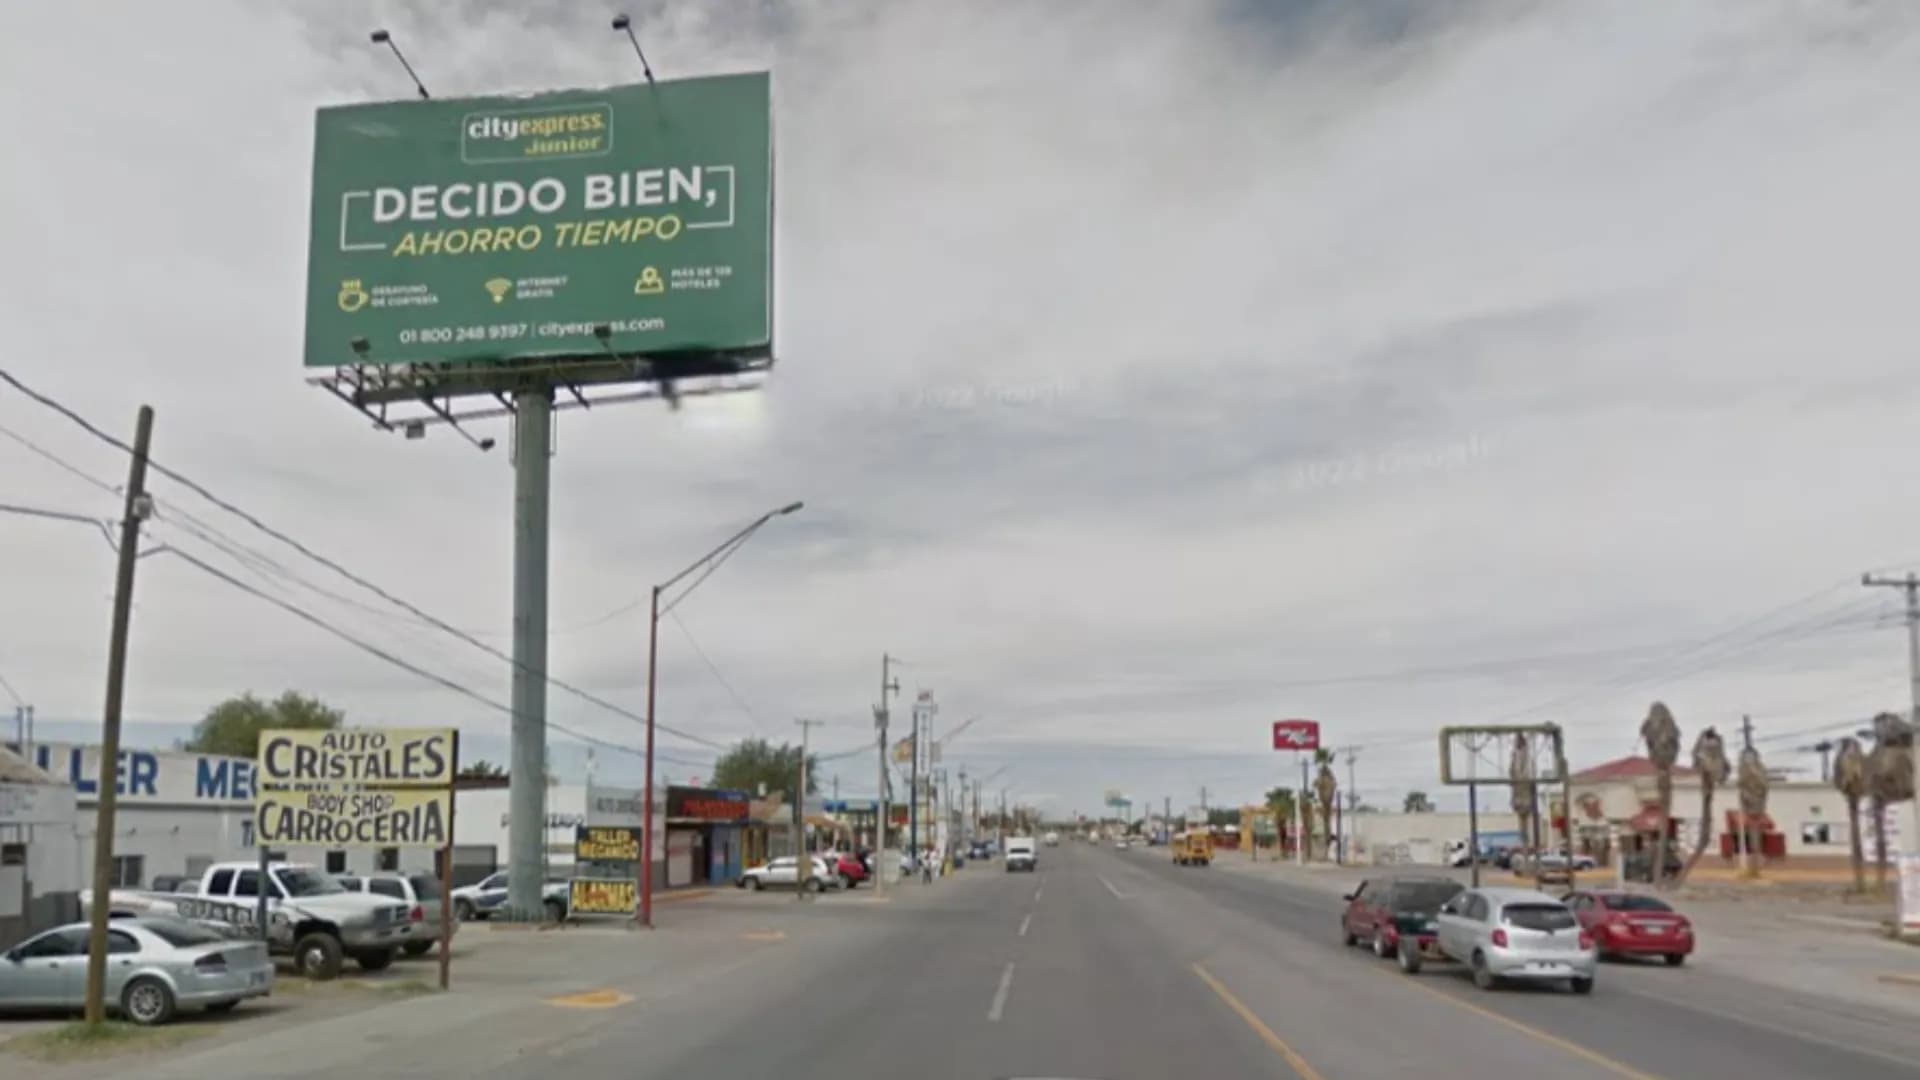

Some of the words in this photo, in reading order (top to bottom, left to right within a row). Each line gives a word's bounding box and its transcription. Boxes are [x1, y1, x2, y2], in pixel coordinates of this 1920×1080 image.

[373, 178, 567, 222] DECIDO
[584, 165, 718, 208] BIEN,
[393, 225, 542, 256] AHORRO
[555, 214, 682, 248] TIEMPO
[265, 736, 445, 779] CRISTALES
[322, 733, 387, 750] AUTO
[258, 798, 446, 843] CARROCERIA
[307, 792, 347, 816] BODY
